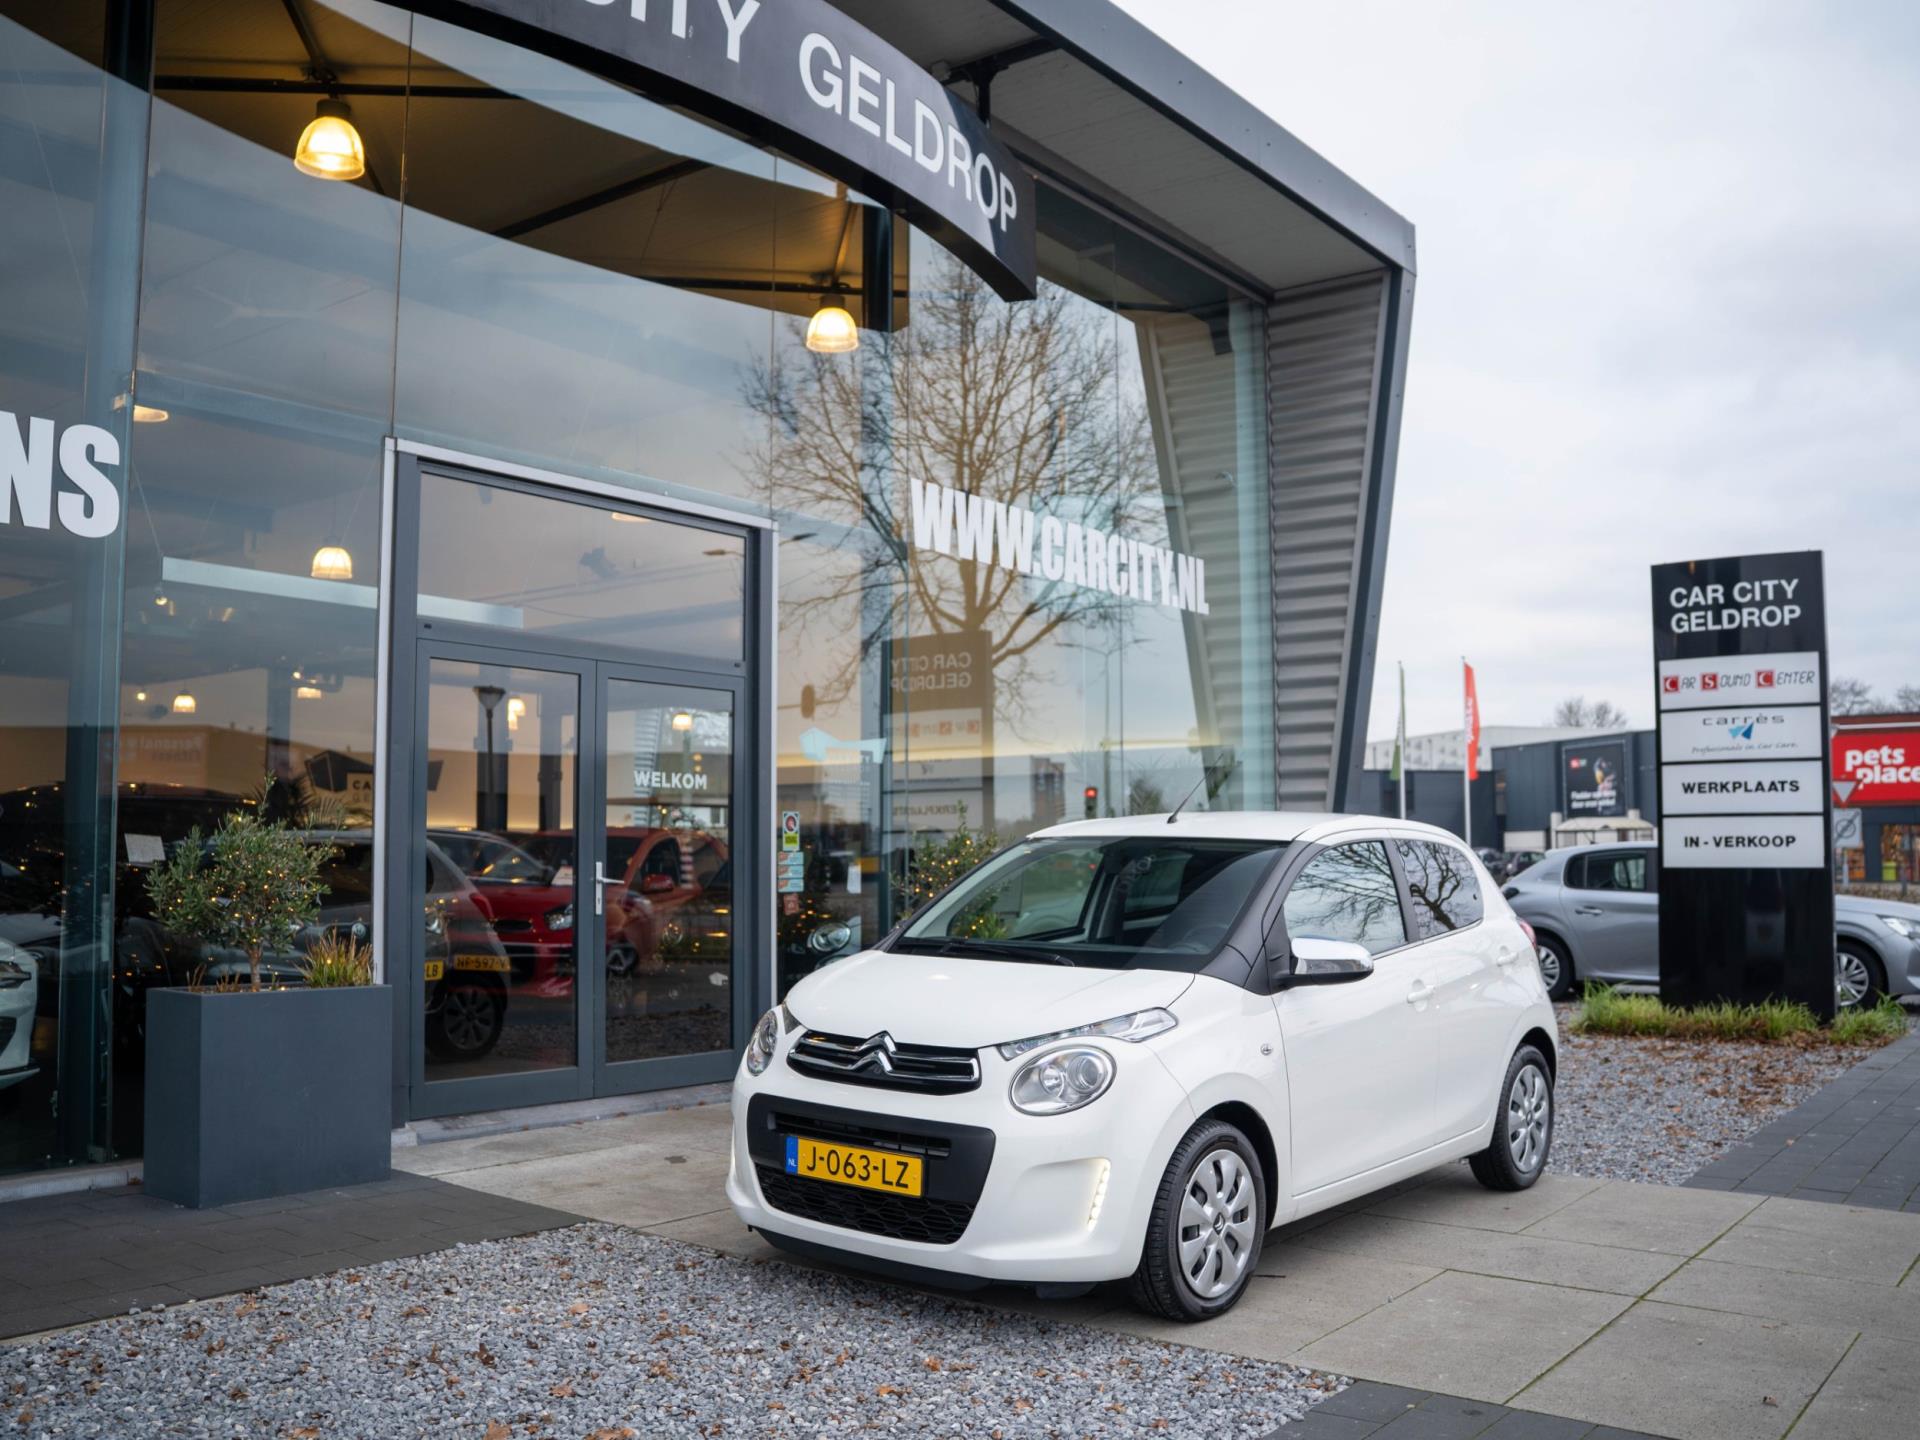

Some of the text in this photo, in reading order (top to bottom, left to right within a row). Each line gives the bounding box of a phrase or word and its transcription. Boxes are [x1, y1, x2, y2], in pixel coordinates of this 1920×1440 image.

[799, 32, 1017, 232] GELDROP
[910, 477, 1210, 616] WWW.CARCITY.NL
[1669, 578, 1799, 608] CAR CITY
[1670, 604, 1802, 633] GELDROP
[1845, 745, 1905, 772] pets
[633, 770, 708, 790] WELKOM
[1681, 780, 1800, 794] WERKPLAATS
[1712, 835, 1796, 848] VERKOOP
[806, 1146, 910, 1189] J-063-LZ
